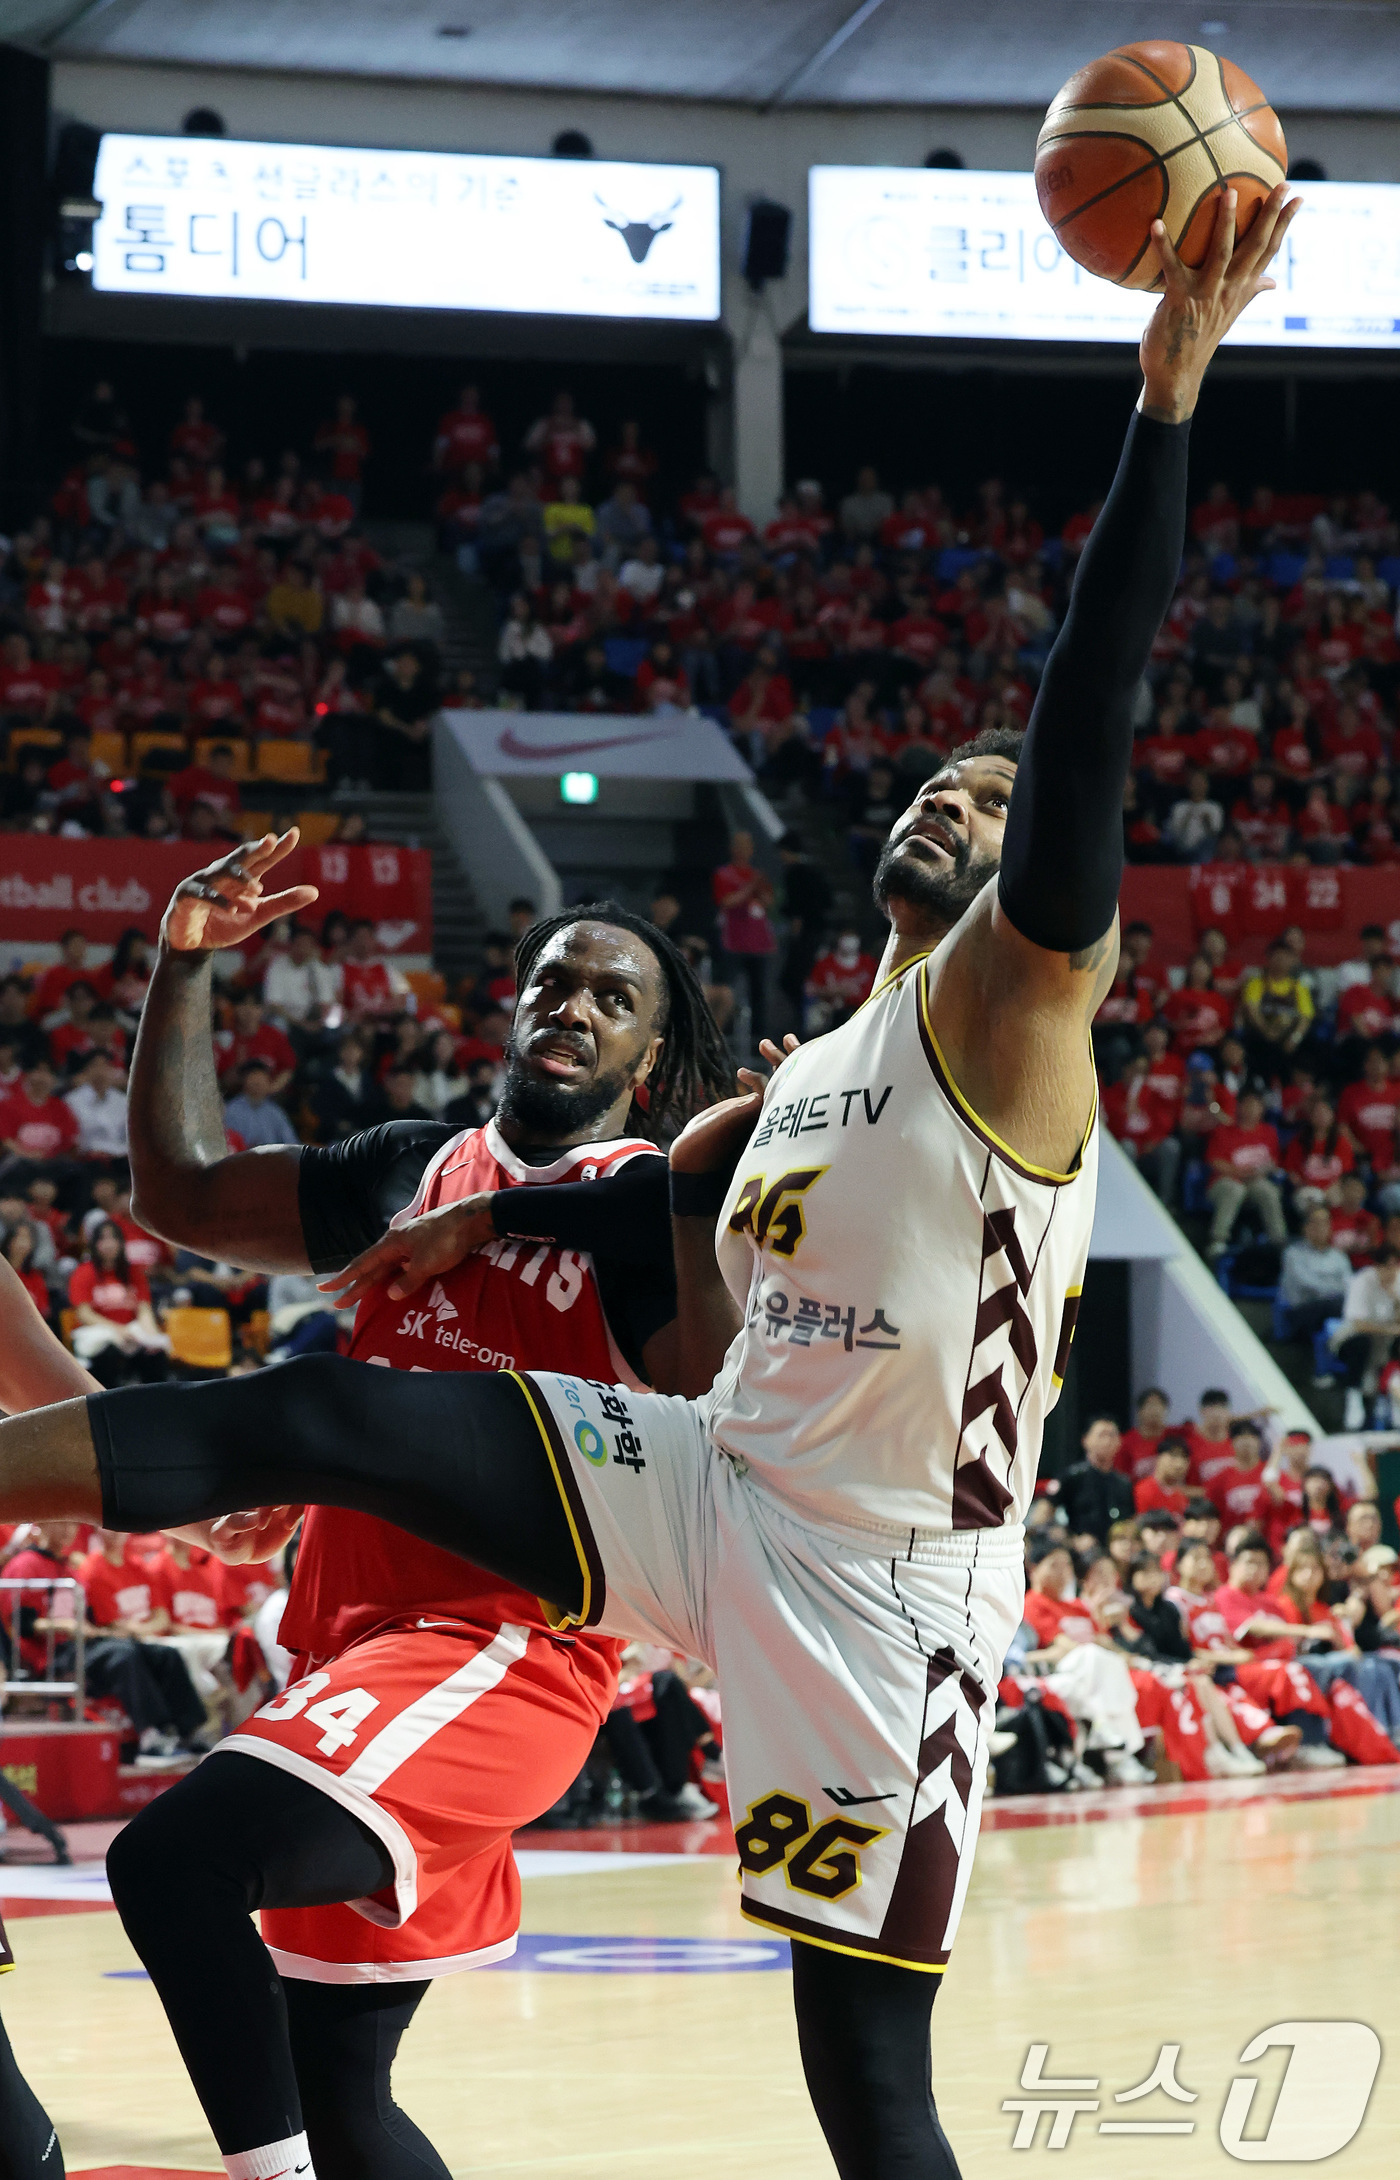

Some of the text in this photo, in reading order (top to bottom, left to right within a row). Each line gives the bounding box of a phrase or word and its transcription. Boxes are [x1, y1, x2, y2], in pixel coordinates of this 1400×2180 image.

[114, 204, 307, 280] 톰디어
[79, 876, 151, 912] club
[753, 1085, 894, 1149] 올레드 TV
[396, 1309, 432, 1339] SK
[435, 1325, 516, 1371] telecom
[749, 1290, 901, 1352] 유플러스
[253, 1672, 381, 1758] 34
[734, 1789, 893, 1904] 86
